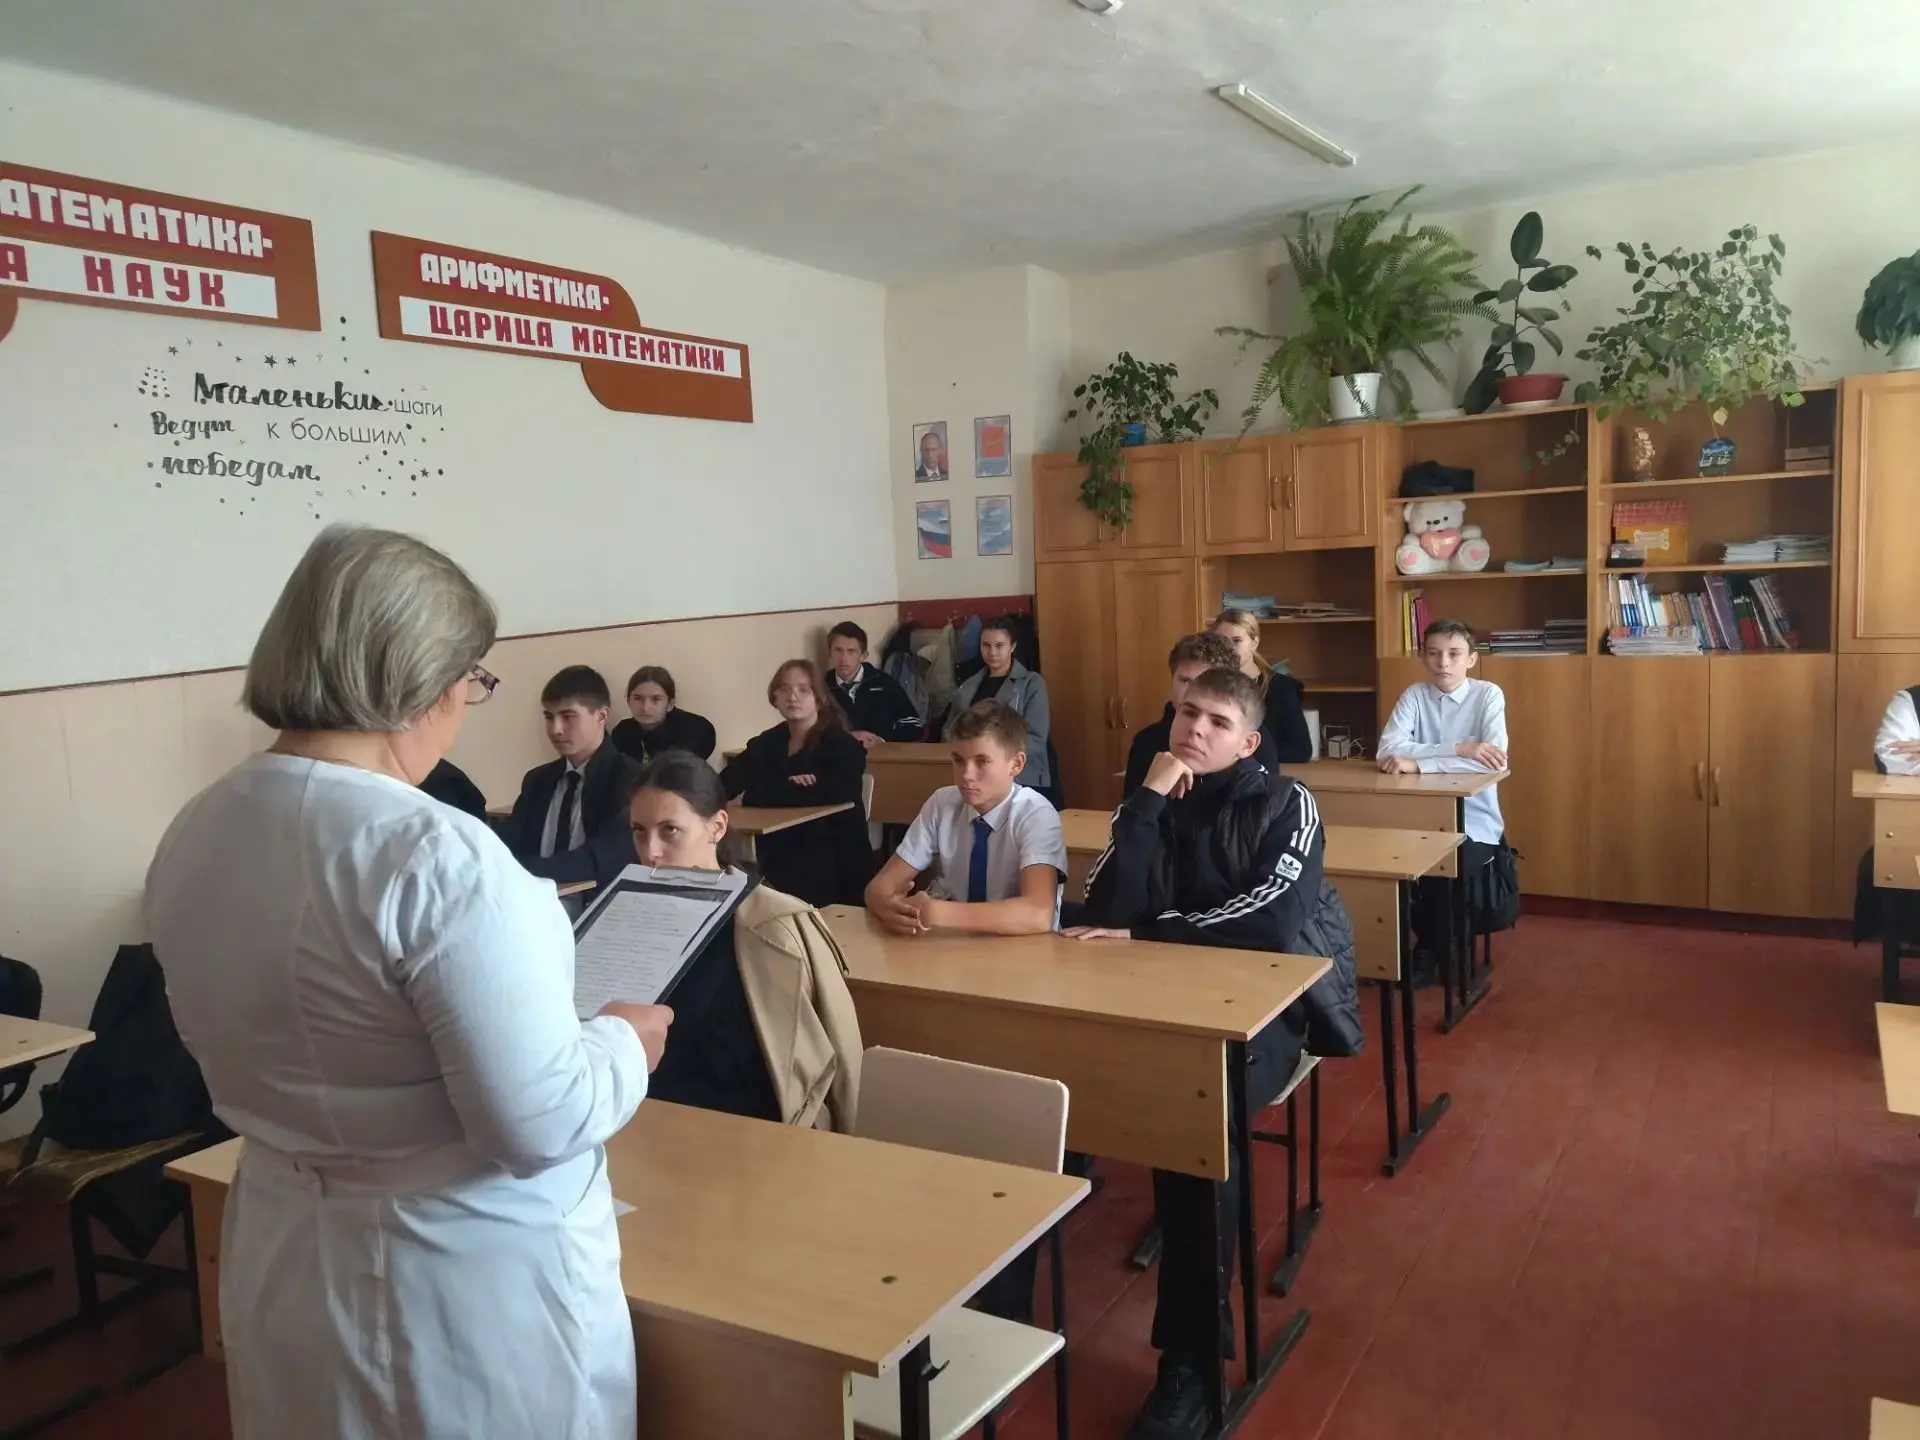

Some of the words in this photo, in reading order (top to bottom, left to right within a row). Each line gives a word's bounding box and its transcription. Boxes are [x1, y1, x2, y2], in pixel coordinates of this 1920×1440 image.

[83, 255, 225, 308] НАУК
[420, 253, 609, 310] АРИФМЕТИКА-
[429, 305, 553, 347] ЦАРИЦА
[571, 325, 725, 372] МАТЕМАТИКИ
[150, 410, 236, 440] Ведут
[291, 417, 406, 446] большим
[394, 399, 443, 416] шаги
